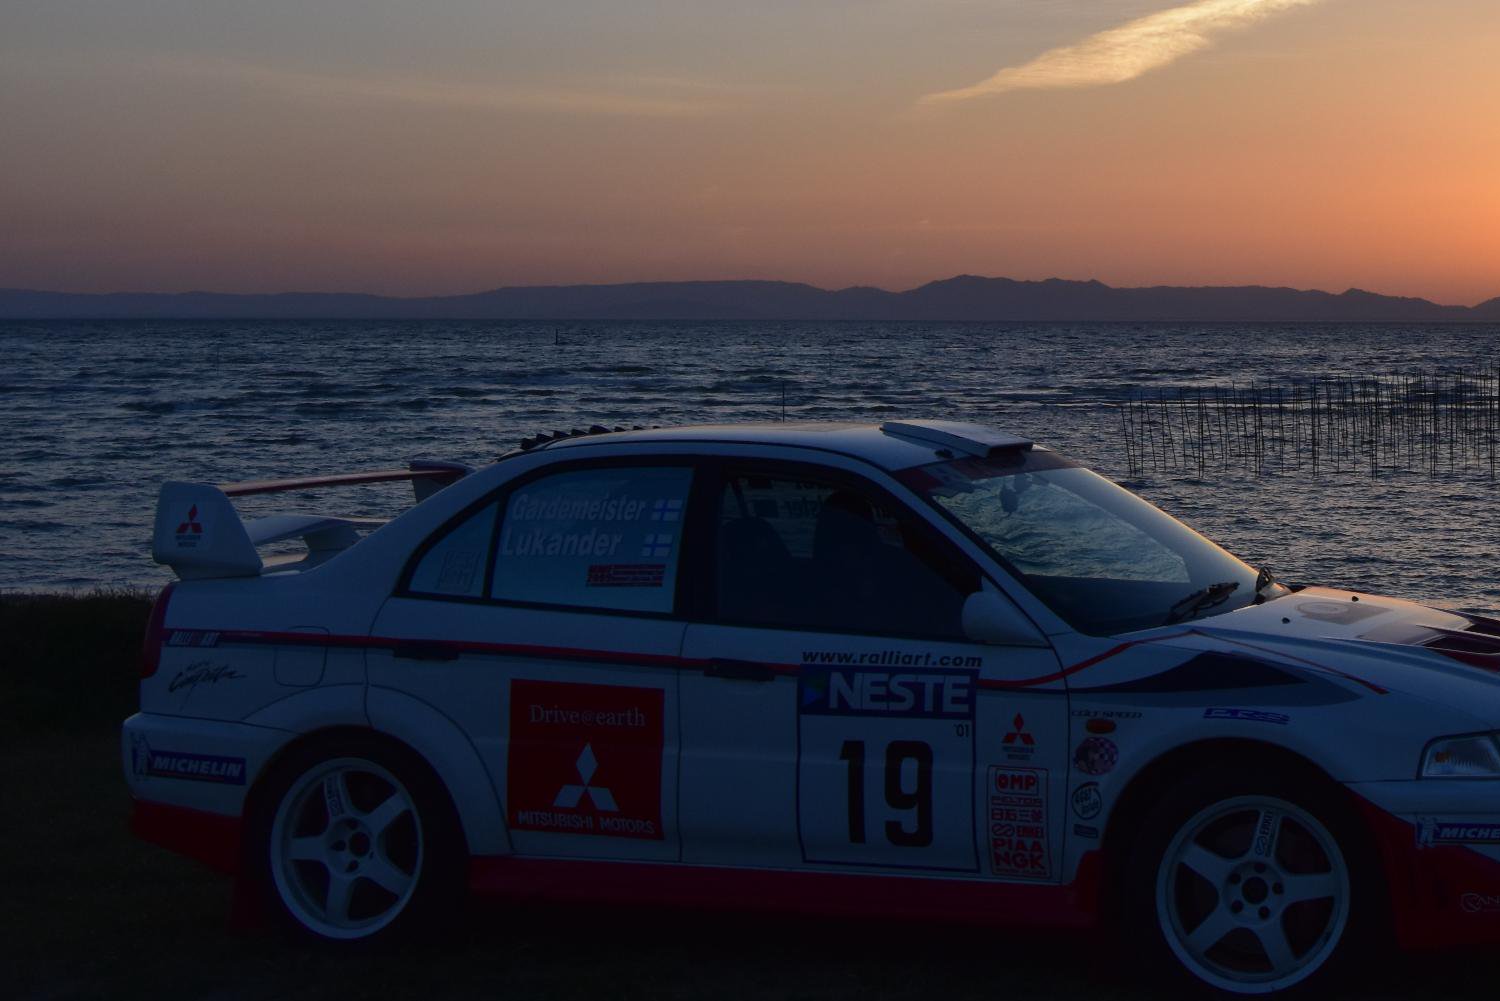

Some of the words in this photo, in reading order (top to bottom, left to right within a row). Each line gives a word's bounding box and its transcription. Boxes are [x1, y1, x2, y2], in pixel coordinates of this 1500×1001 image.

[501, 527, 623, 557] Lukander
[802, 650, 982, 669] www.ralliart.com
[828, 671, 970, 713] NESTE
[152, 755, 242, 777] MICHELIN
[998, 773, 1036, 790] OMP
[840, 740, 933, 846] 19
[517, 809, 594, 831] MITSUBISHI
[600, 817, 656, 834] MOTORS
[993, 838, 1044, 853] PIAA
[994, 852, 1045, 869] NGK
